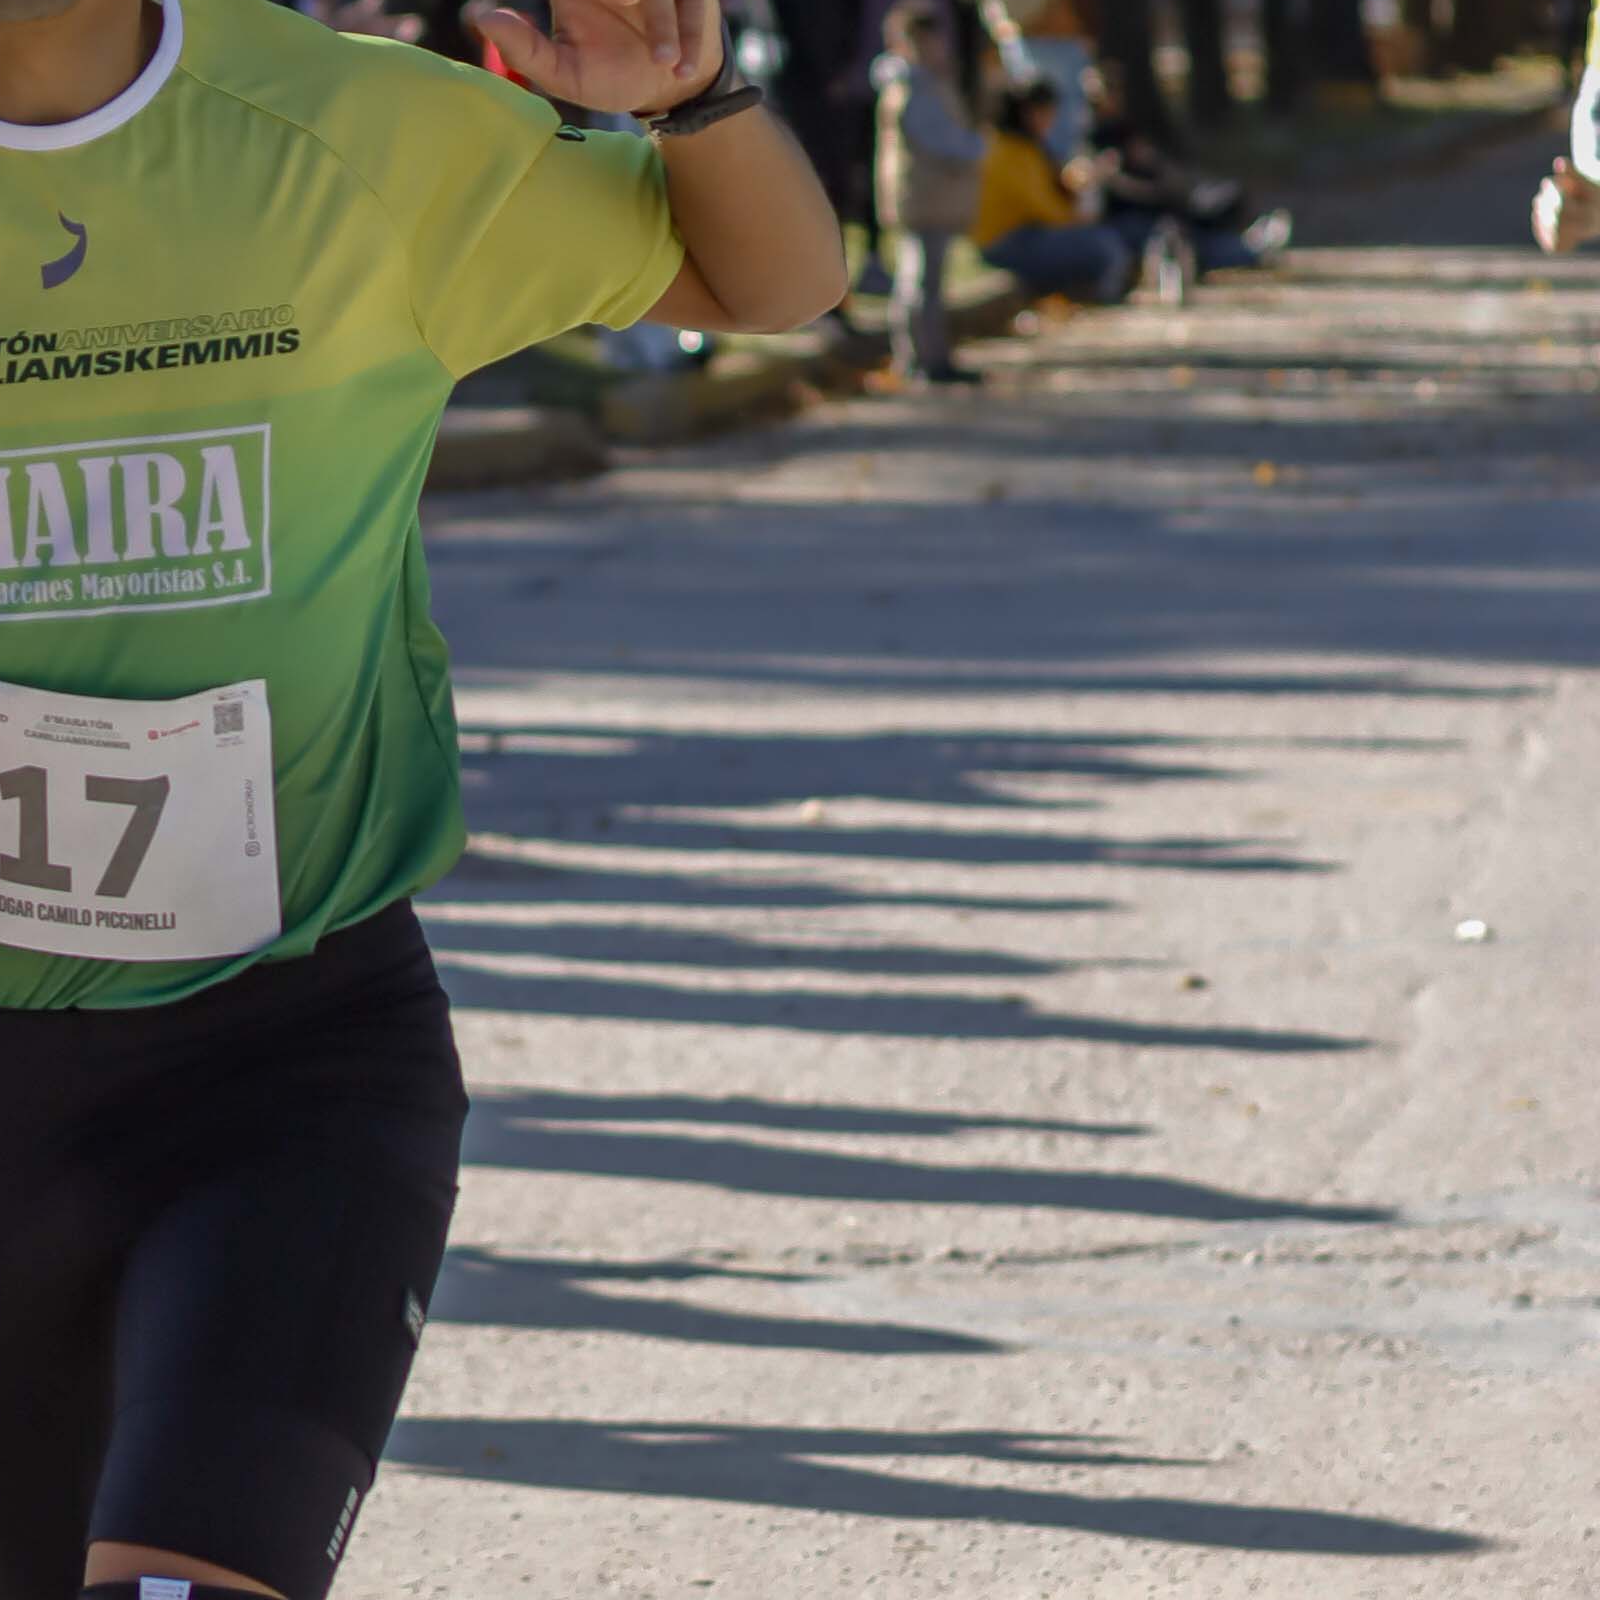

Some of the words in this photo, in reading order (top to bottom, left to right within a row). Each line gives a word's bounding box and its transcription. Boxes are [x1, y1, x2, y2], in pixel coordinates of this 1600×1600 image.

[81, 566, 206, 601] Mayoristas
[212, 559, 253, 588] S.A.
[37, 903, 92, 927] CAMILO
[95, 910, 177, 931] PICCINELLI
